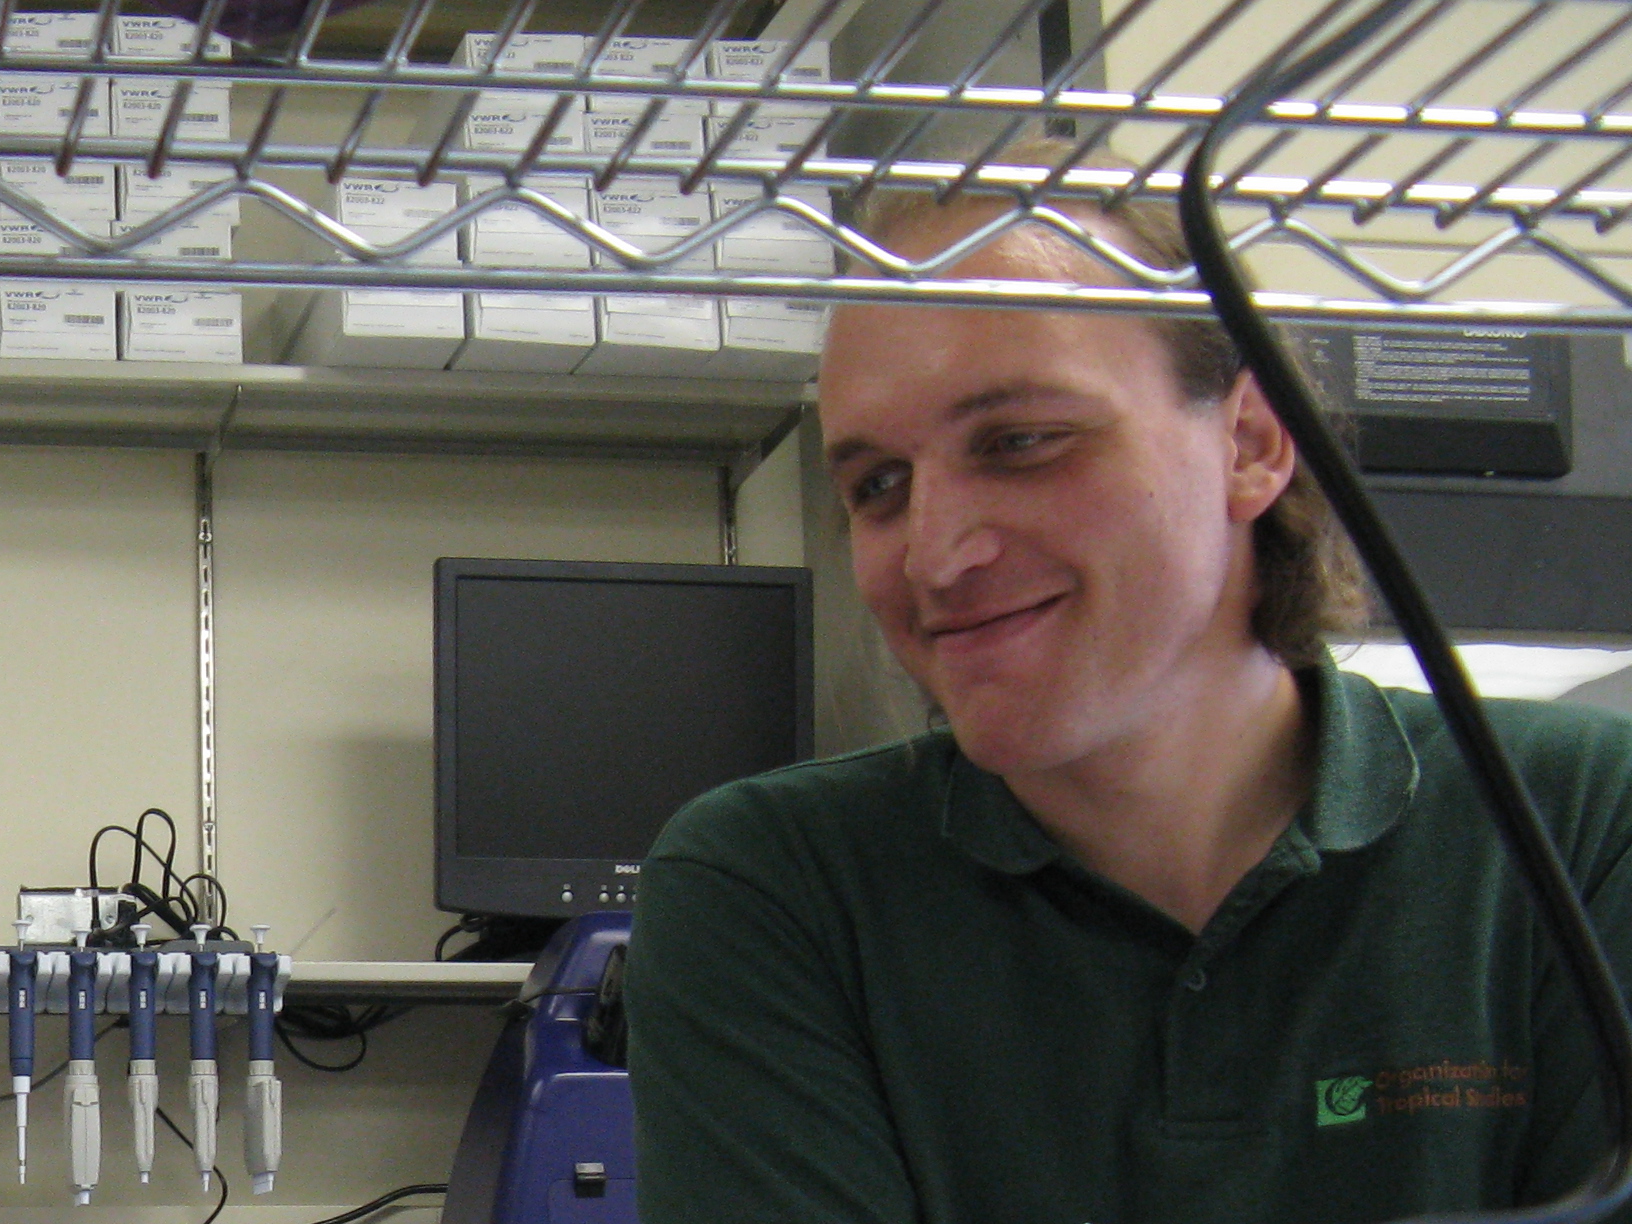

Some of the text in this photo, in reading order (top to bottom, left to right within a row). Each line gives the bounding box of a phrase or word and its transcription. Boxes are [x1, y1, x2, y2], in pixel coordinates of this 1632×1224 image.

[123, 20, 153, 28] VWR
[0, 86, 29, 94] VWR
[121, 89, 152, 97] VWR
[471, 114, 501, 122] VWR
[591, 118, 620, 126] VWR
[134, 294, 165, 302] VWR
